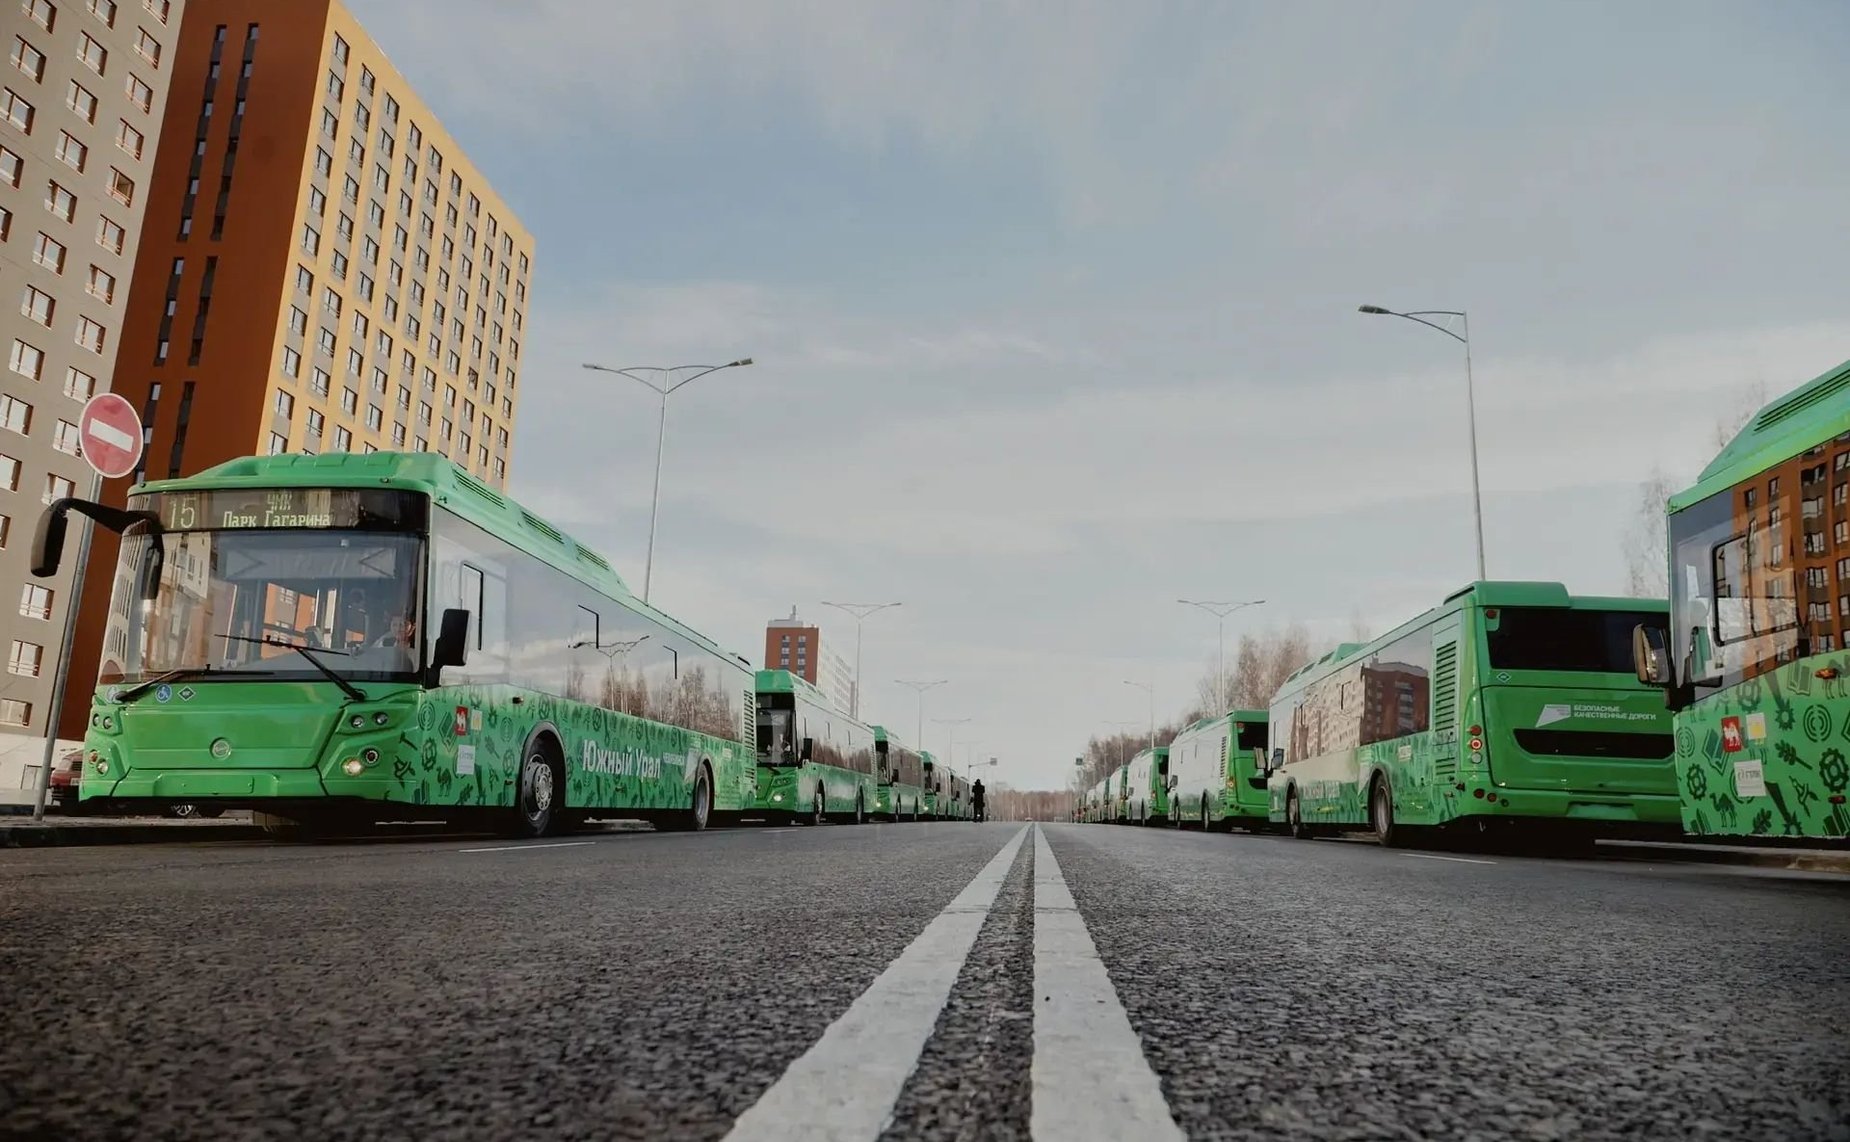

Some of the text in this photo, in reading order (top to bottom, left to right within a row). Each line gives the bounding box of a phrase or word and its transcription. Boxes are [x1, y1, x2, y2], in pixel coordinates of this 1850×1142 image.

[169, 497, 197, 529] 15
[222, 509, 332, 528] Парк Гагарина
[1628, 712, 1657, 721] ДОРОГИ
[582, 739, 633, 777] Южный
[635, 747, 661, 783] Урал
